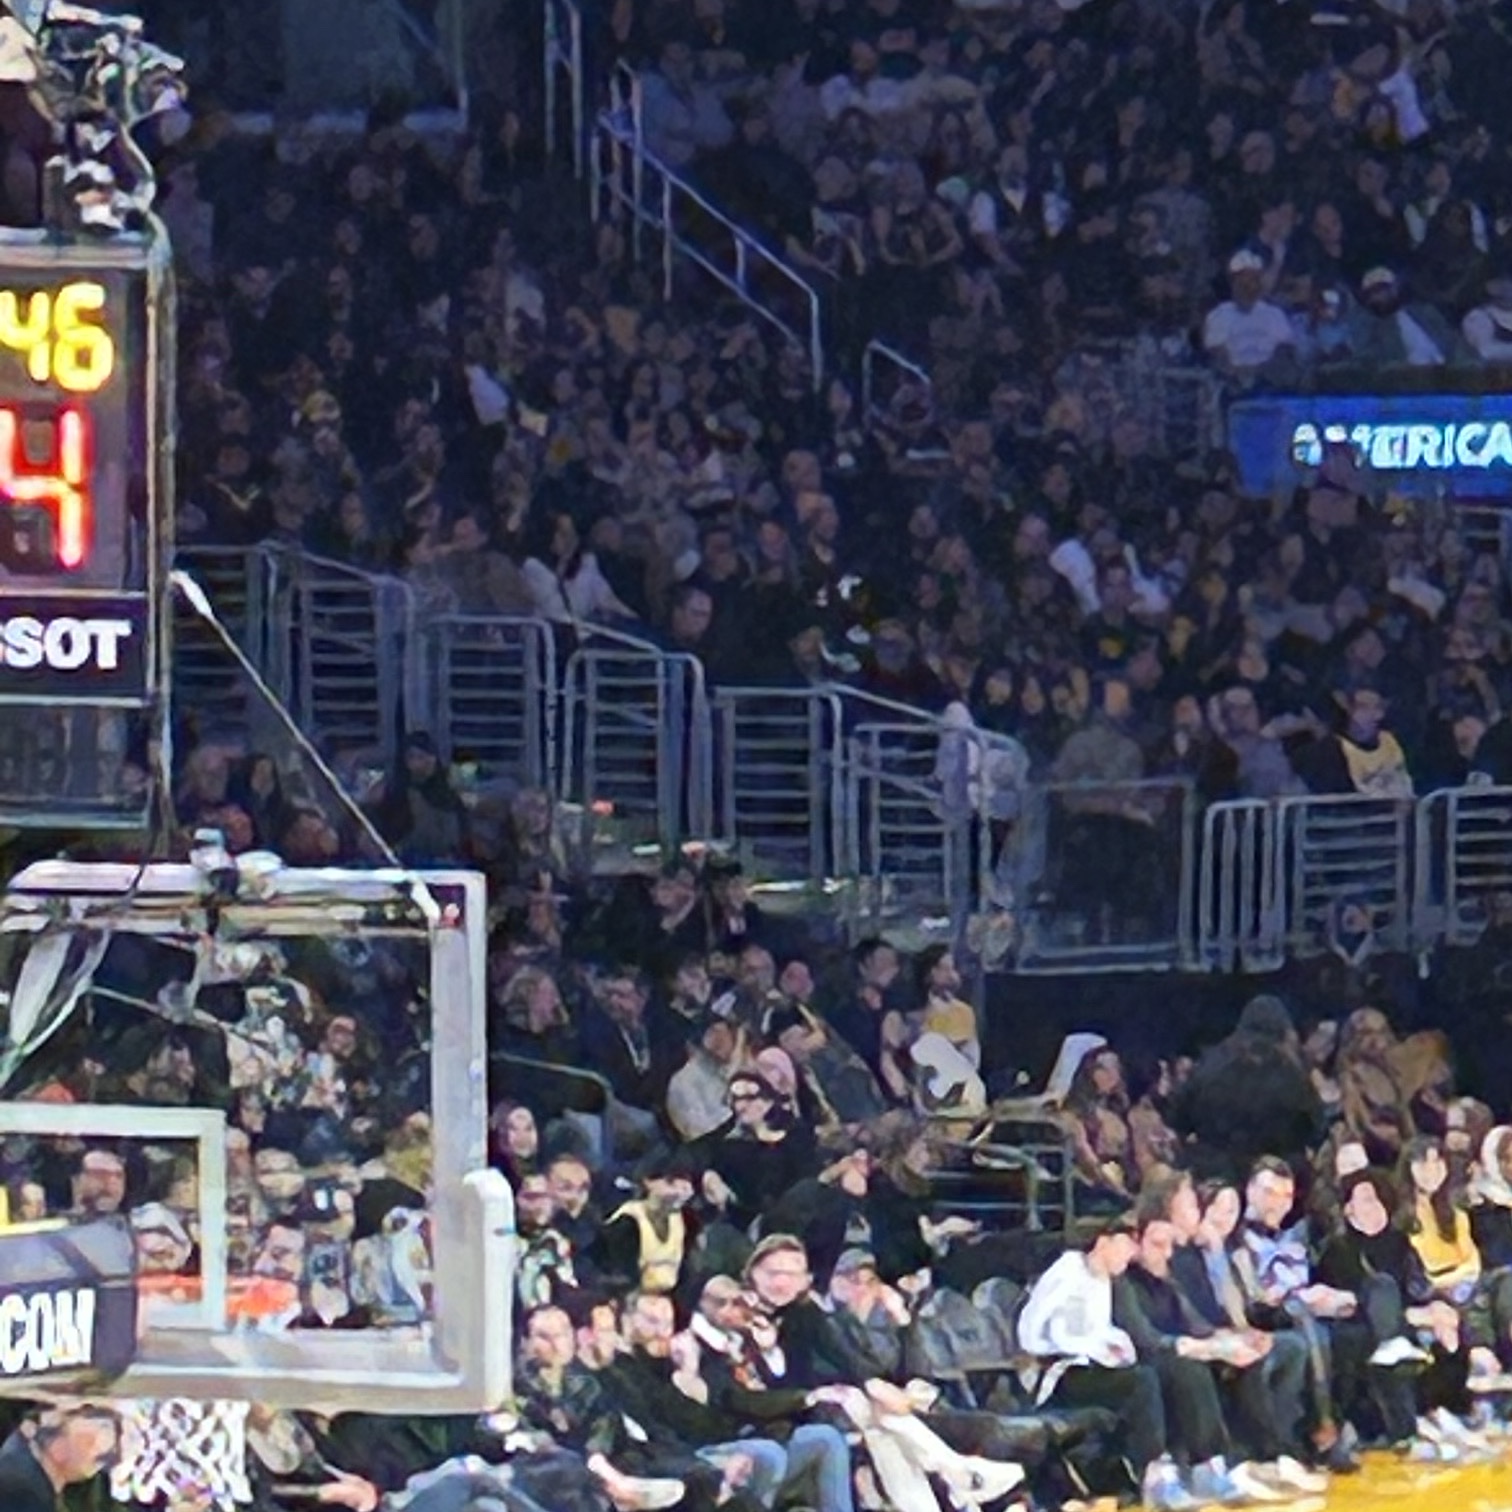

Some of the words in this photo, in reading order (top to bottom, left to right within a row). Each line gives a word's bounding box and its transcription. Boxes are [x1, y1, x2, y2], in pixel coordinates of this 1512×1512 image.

[0, 281, 114, 391] 46
[0, 409, 84, 567] 4
[0, 616, 132, 670] SOT
